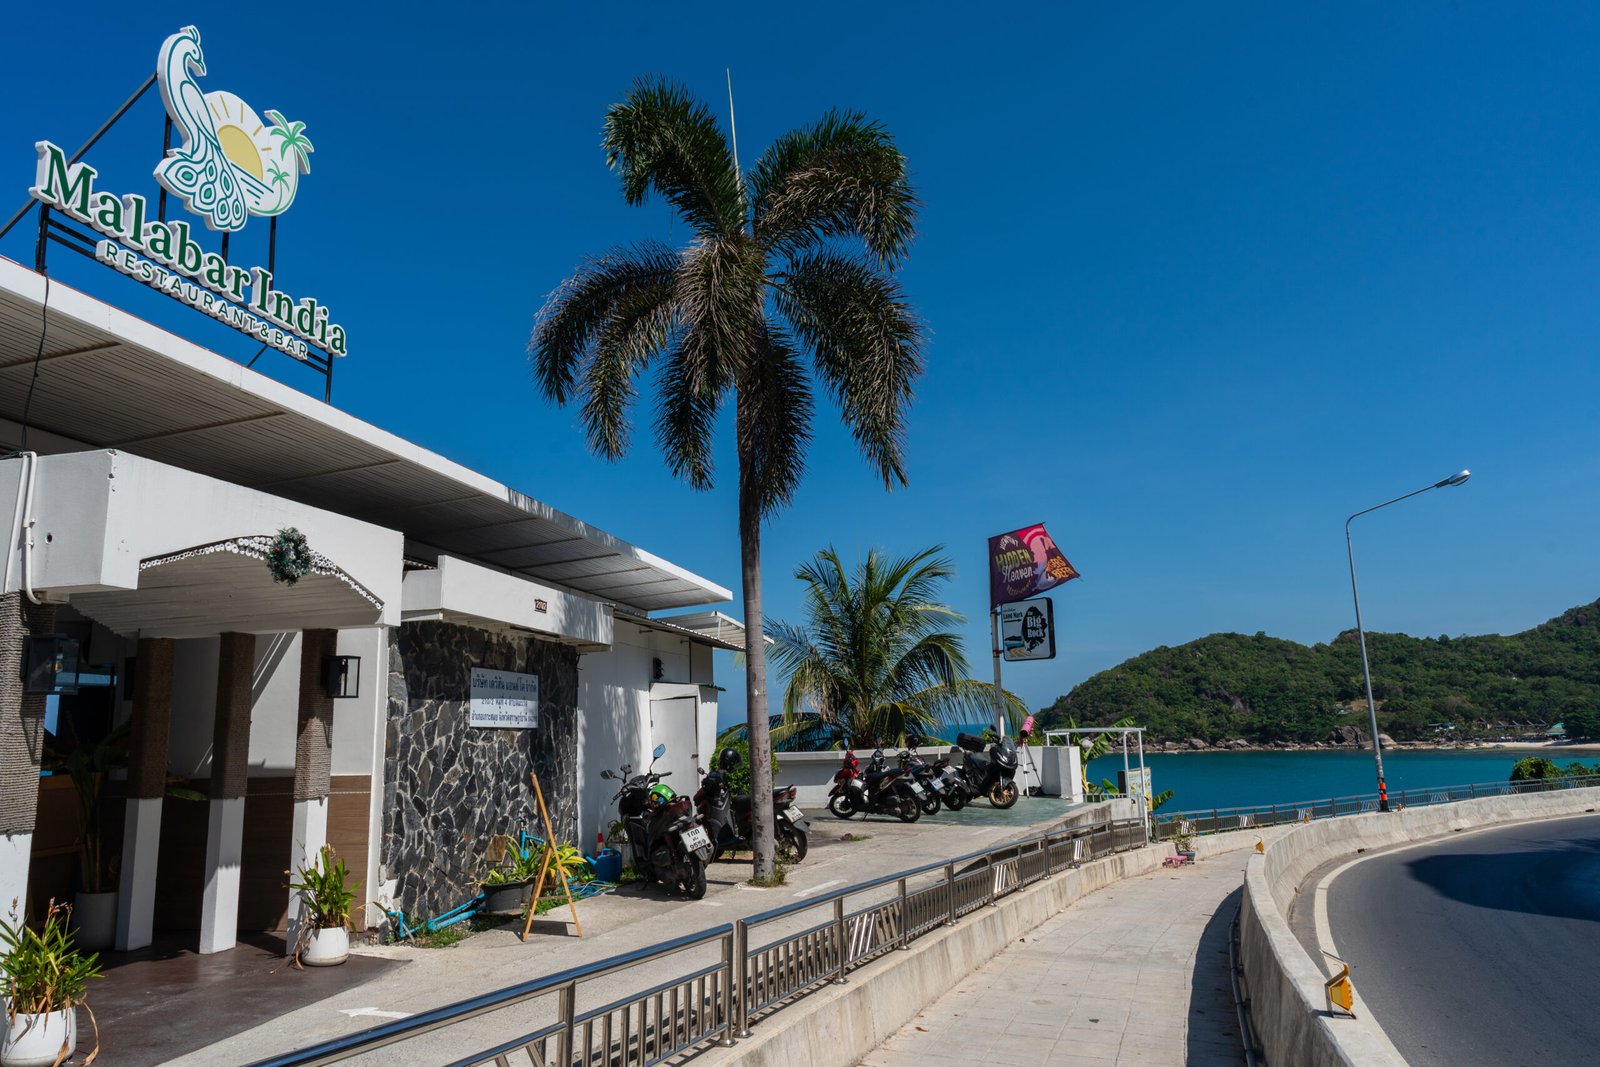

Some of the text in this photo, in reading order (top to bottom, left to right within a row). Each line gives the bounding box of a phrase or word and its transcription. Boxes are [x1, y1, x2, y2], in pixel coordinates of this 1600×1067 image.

[36, 140, 347, 356] Malabar India
[995, 549, 1033, 572] HIDDEN
[1026, 615, 1042, 628] Big
